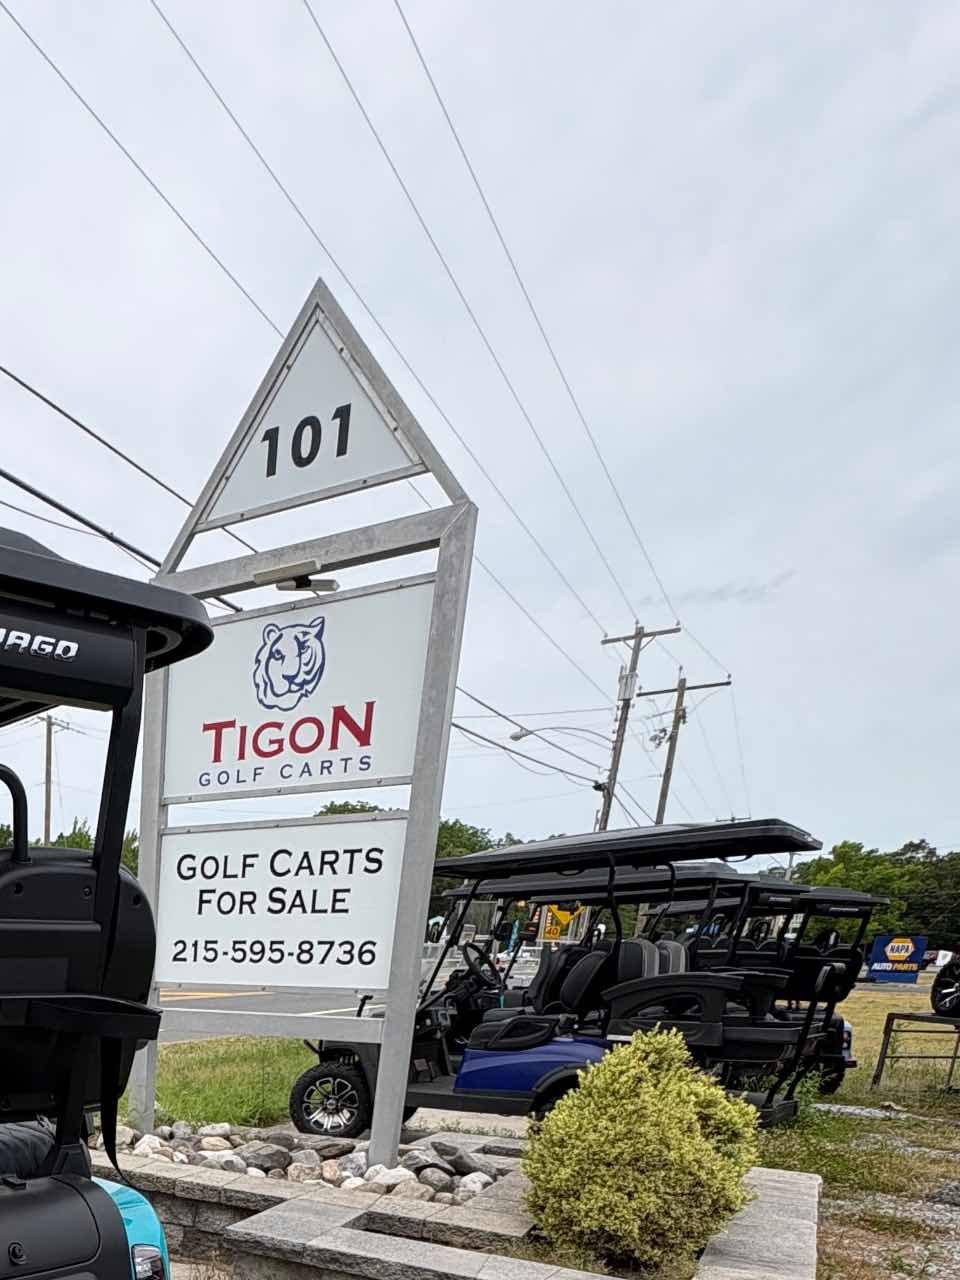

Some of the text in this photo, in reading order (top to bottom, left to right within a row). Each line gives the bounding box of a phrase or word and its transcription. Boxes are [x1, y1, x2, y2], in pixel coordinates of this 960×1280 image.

[260, 402, 353, 479] 101
[202, 700, 377, 764] TIGON
[198, 755, 373, 787] GOLF CARTS
[176, 847, 385, 881] GOLF CARTS
[197, 886, 352, 916] FOR SALE
[172, 939, 378, 966] 215-595-8736
[889, 944, 910, 954] NAPA
[871, 962, 919, 971] AUTO PARTS
